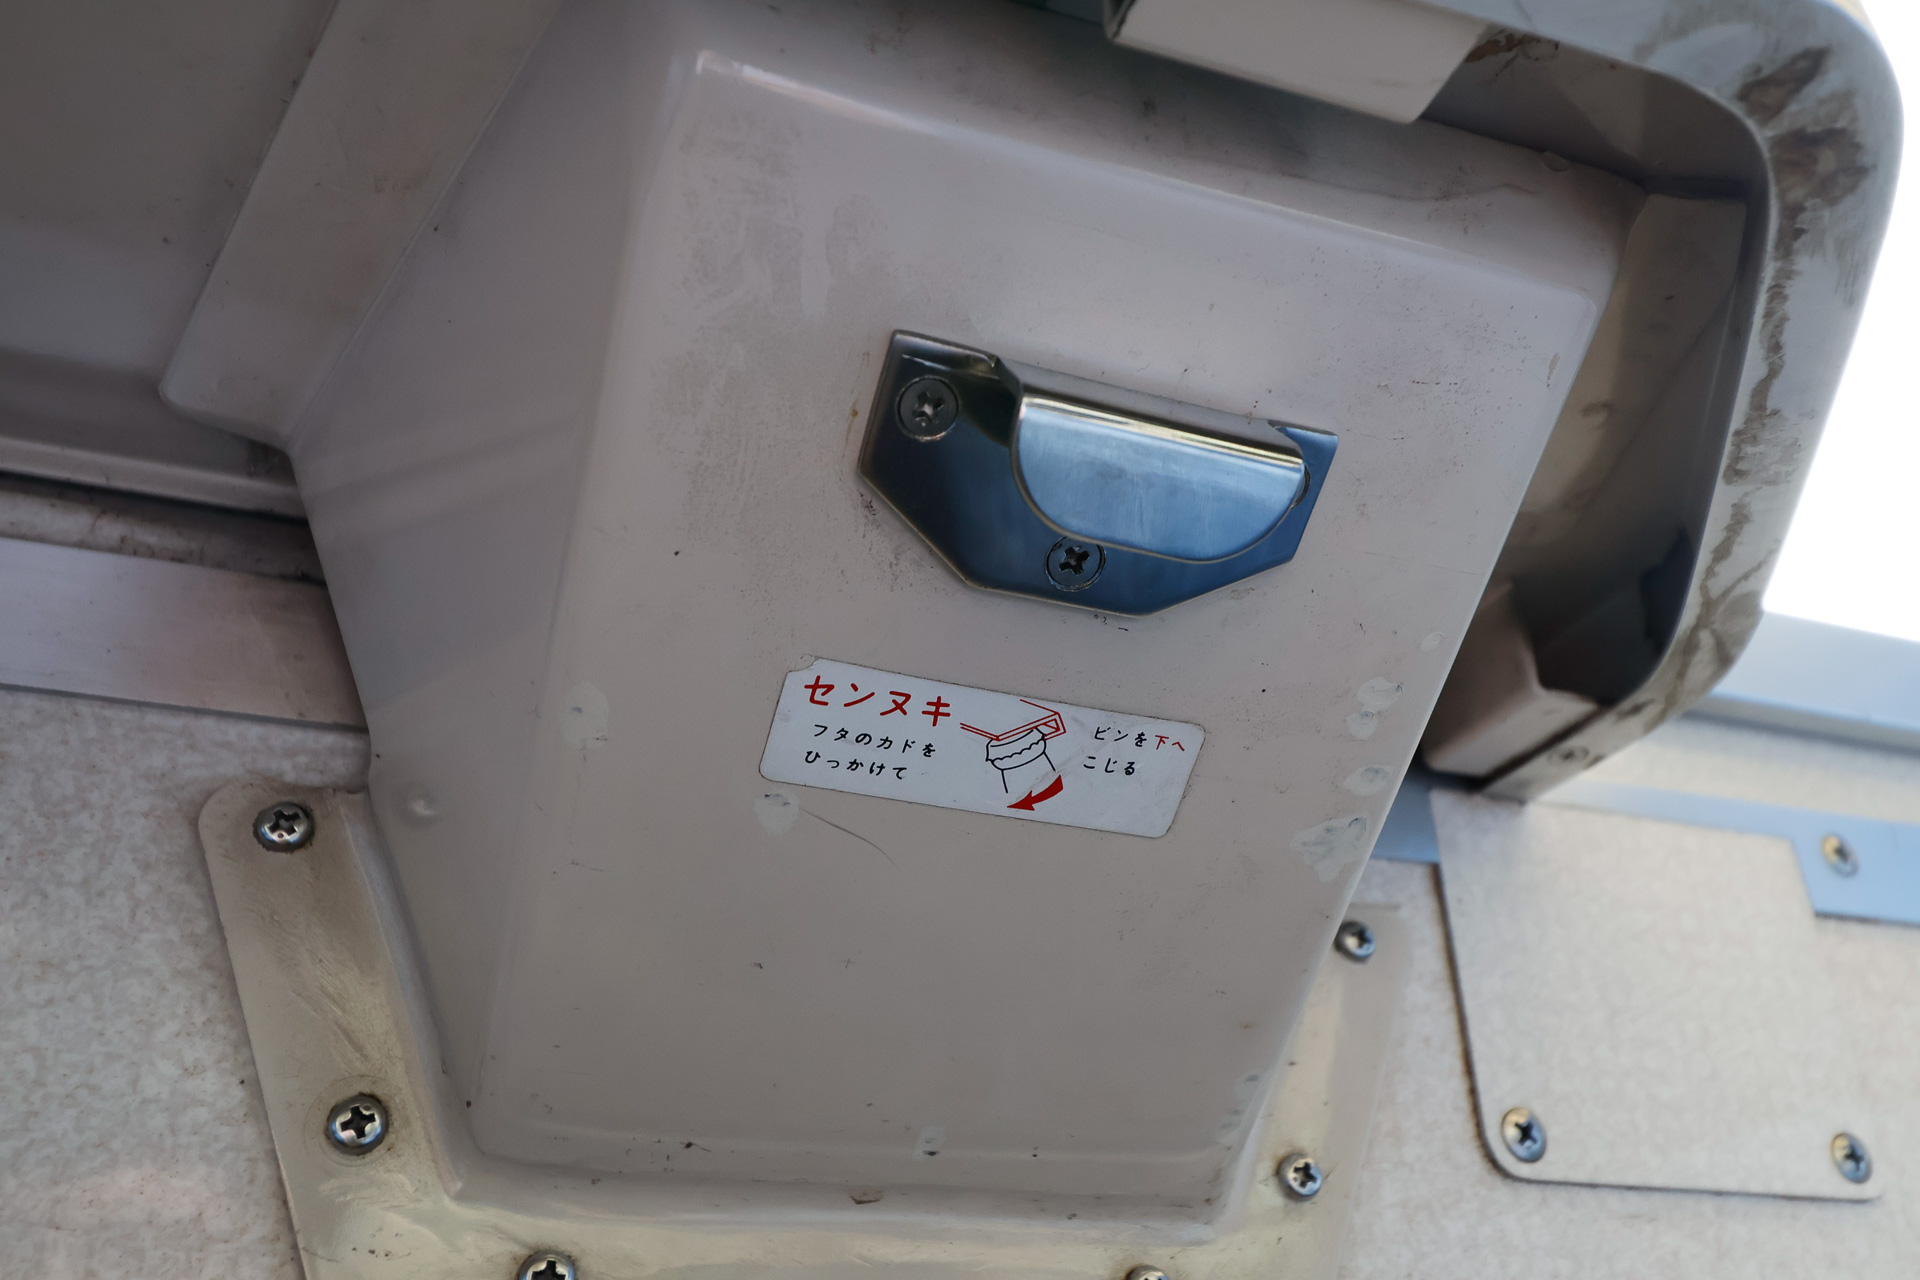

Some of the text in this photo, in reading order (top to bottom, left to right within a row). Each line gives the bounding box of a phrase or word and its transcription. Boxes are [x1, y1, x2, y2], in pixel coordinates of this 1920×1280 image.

[804, 675, 951, 727] センヌキ
[813, 723, 936, 758] フタのカドを
[1093, 726, 1185, 752] ビンを下へ
[804, 750, 908, 780] ひっかけて
[1083, 755, 1136, 776] こじる
